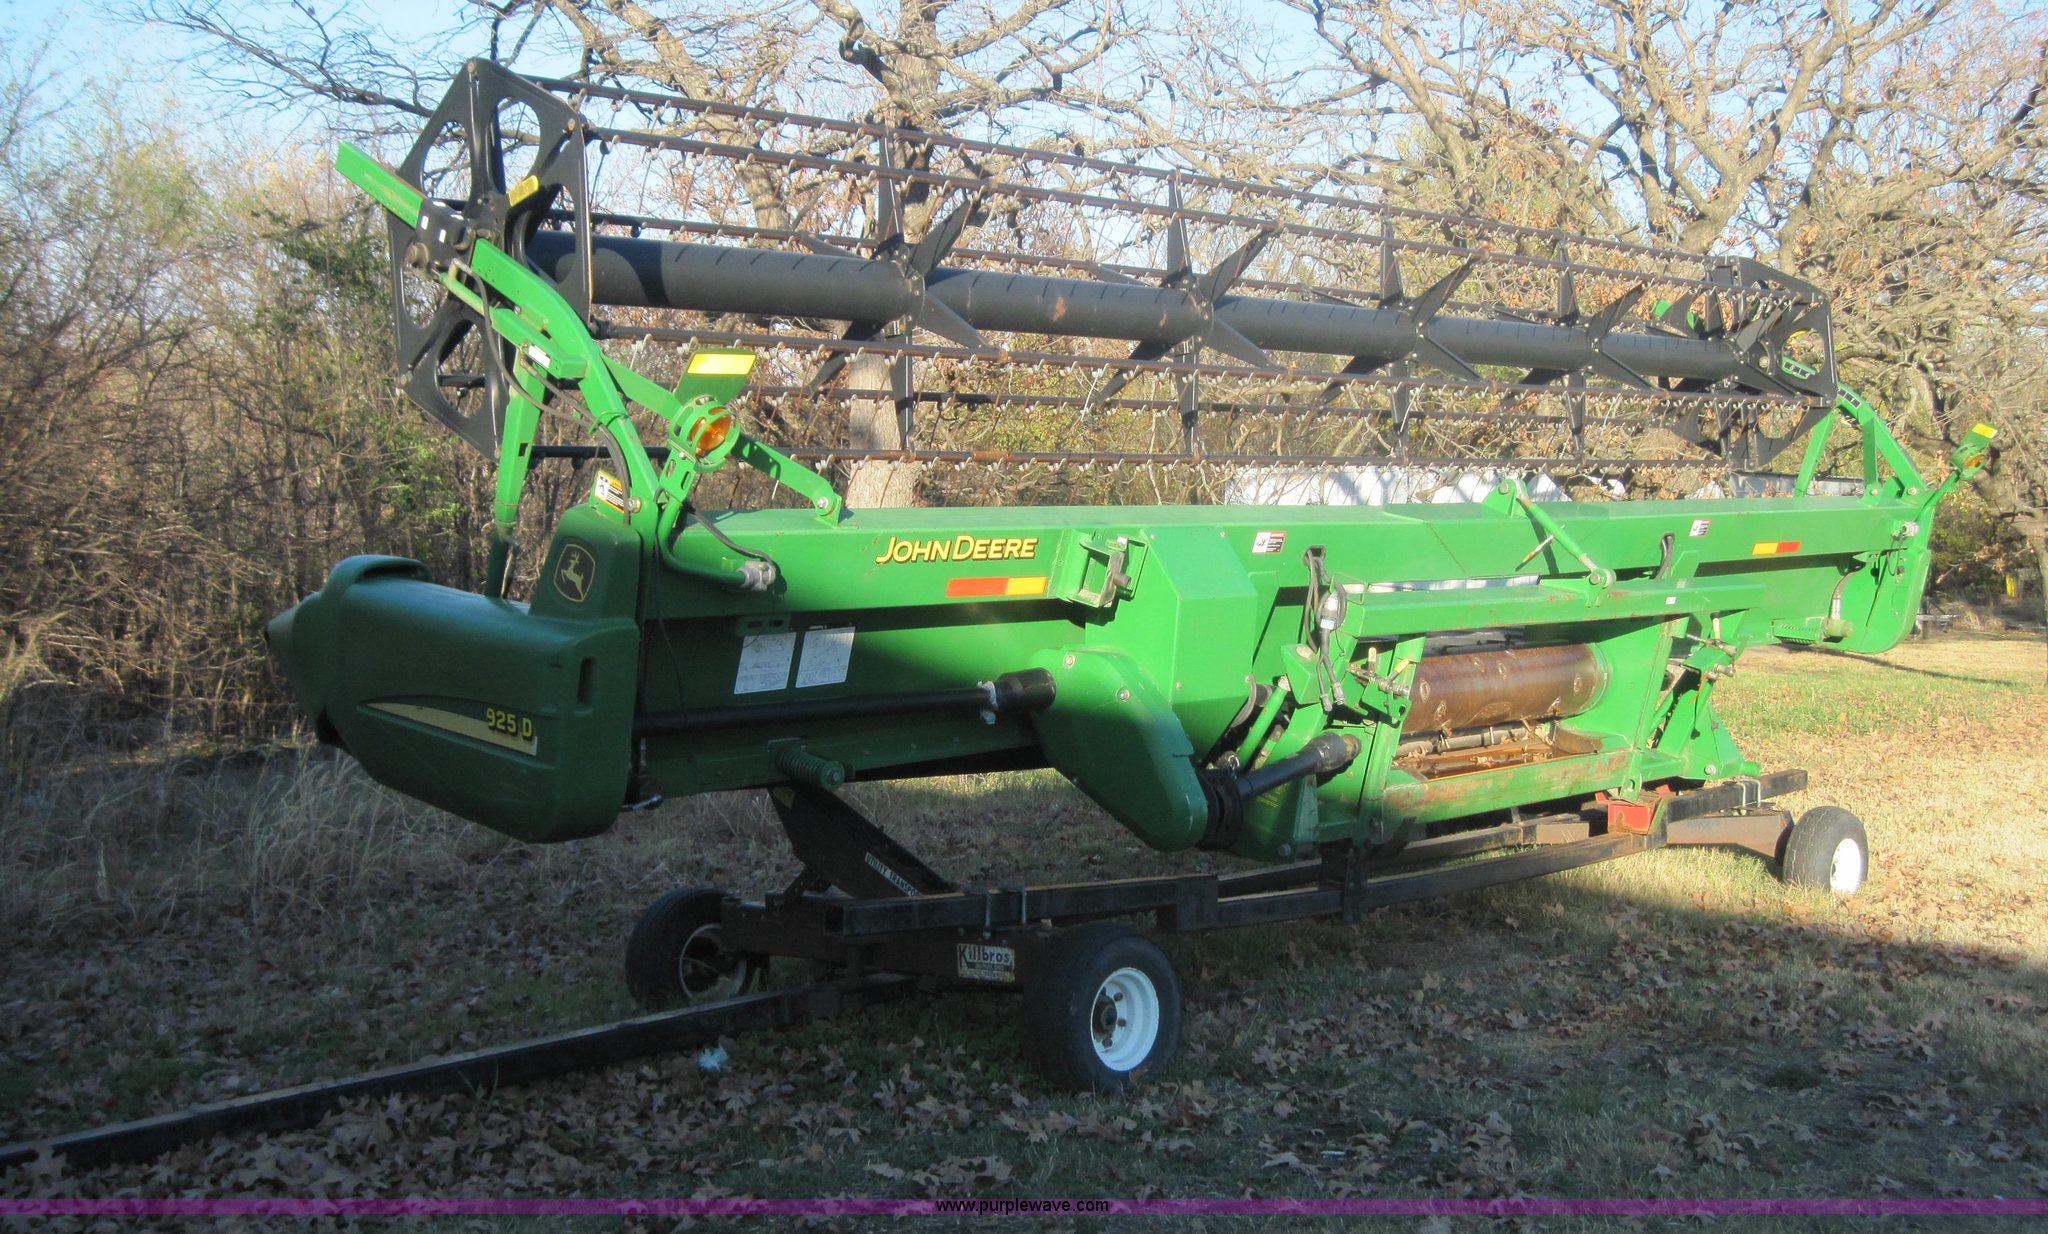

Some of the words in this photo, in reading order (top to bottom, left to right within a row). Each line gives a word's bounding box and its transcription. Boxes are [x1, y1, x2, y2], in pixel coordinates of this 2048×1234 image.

[876, 536, 951, 563] JOHN
[952, 535, 1039, 560] DEERE
[486, 708, 517, 733] 925
[522, 717, 532, 737] D
[959, 945, 1010, 970] Killbros
